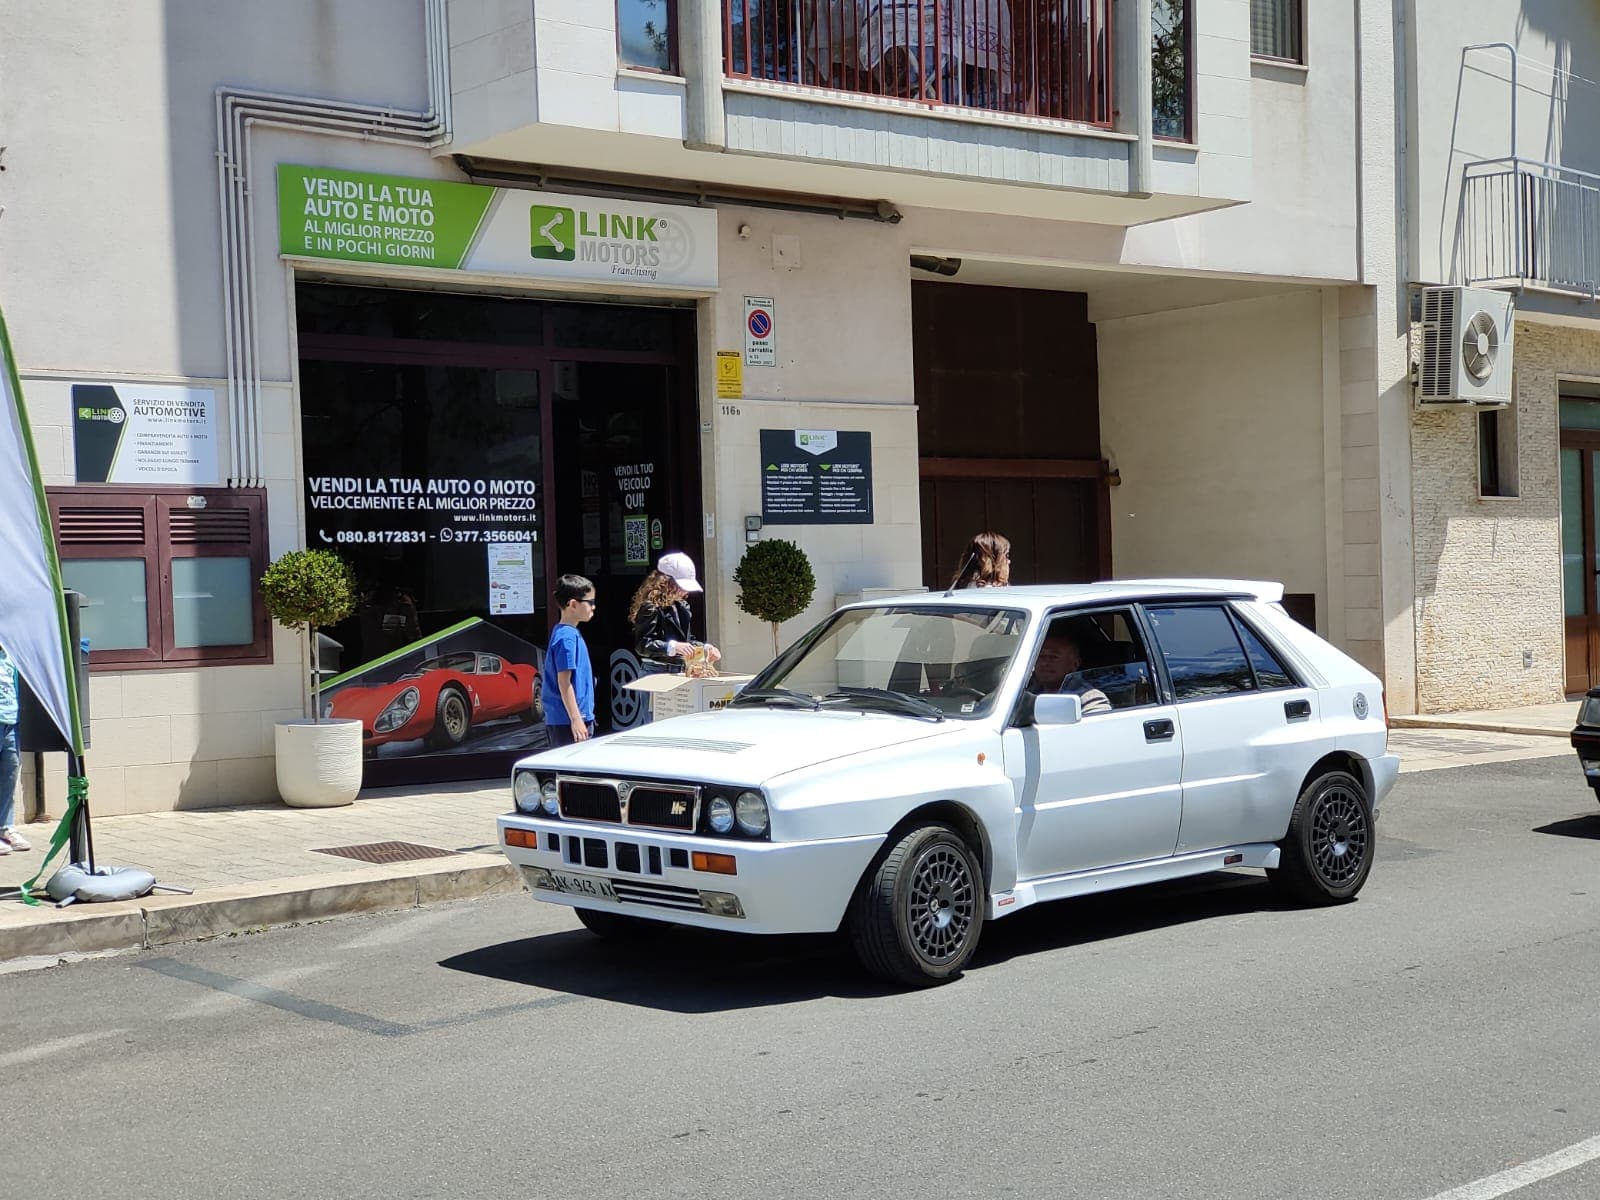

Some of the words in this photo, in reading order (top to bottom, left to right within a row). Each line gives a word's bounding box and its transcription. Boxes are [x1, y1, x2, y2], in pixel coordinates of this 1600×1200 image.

[303, 177, 364, 200] VENDI
[368, 182, 393, 203] LA
[395, 186, 433, 208] TUA
[304, 198, 358, 220] AUTO
[363, 202, 373, 222] E
[378, 205, 435, 227] MOTO
[304, 219, 322, 234] AL
[325, 221, 382, 239] MIGLIOR
[384, 226, 434, 244] PREZZO
[304, 235, 313, 250] E
[317, 236, 332, 251] IN
[337, 238, 382, 256] POCHI
[385, 242, 435, 260] GIORNI
[580, 240, 660, 267] MOTORS
[610, 264, 658, 280] Franchising
[133, 399, 165, 407] SERVIZIO
[133, 406, 206, 418] AUTOMOTIVE
[615, 465, 633, 477] VENDI
[633, 464, 639, 475] IL
[640, 463, 654, 475] TUO
[309, 477, 361, 493] VENDI
[366, 478, 387, 494] LA
[389, 478, 423, 494] TUA
[427, 479, 470, 495] AUTO
[474, 480, 486, 495] O
[490, 480, 536, 495] MOTO
[618, 476, 651, 491] VEICOLO
[310, 495, 405, 510] VELOCEMENTE
[408, 497, 415, 510] E
[417, 497, 434, 510] AL
[436, 497, 488, 510] MIGLIOR
[490, 497, 536, 510] PREZZO
[625, 492, 645, 509] QUI!
[454, 513, 537, 522] www.linkmotors.it
[336, 531, 426, 543] 080.8172831
[455, 530, 538, 543] 377.3566041
